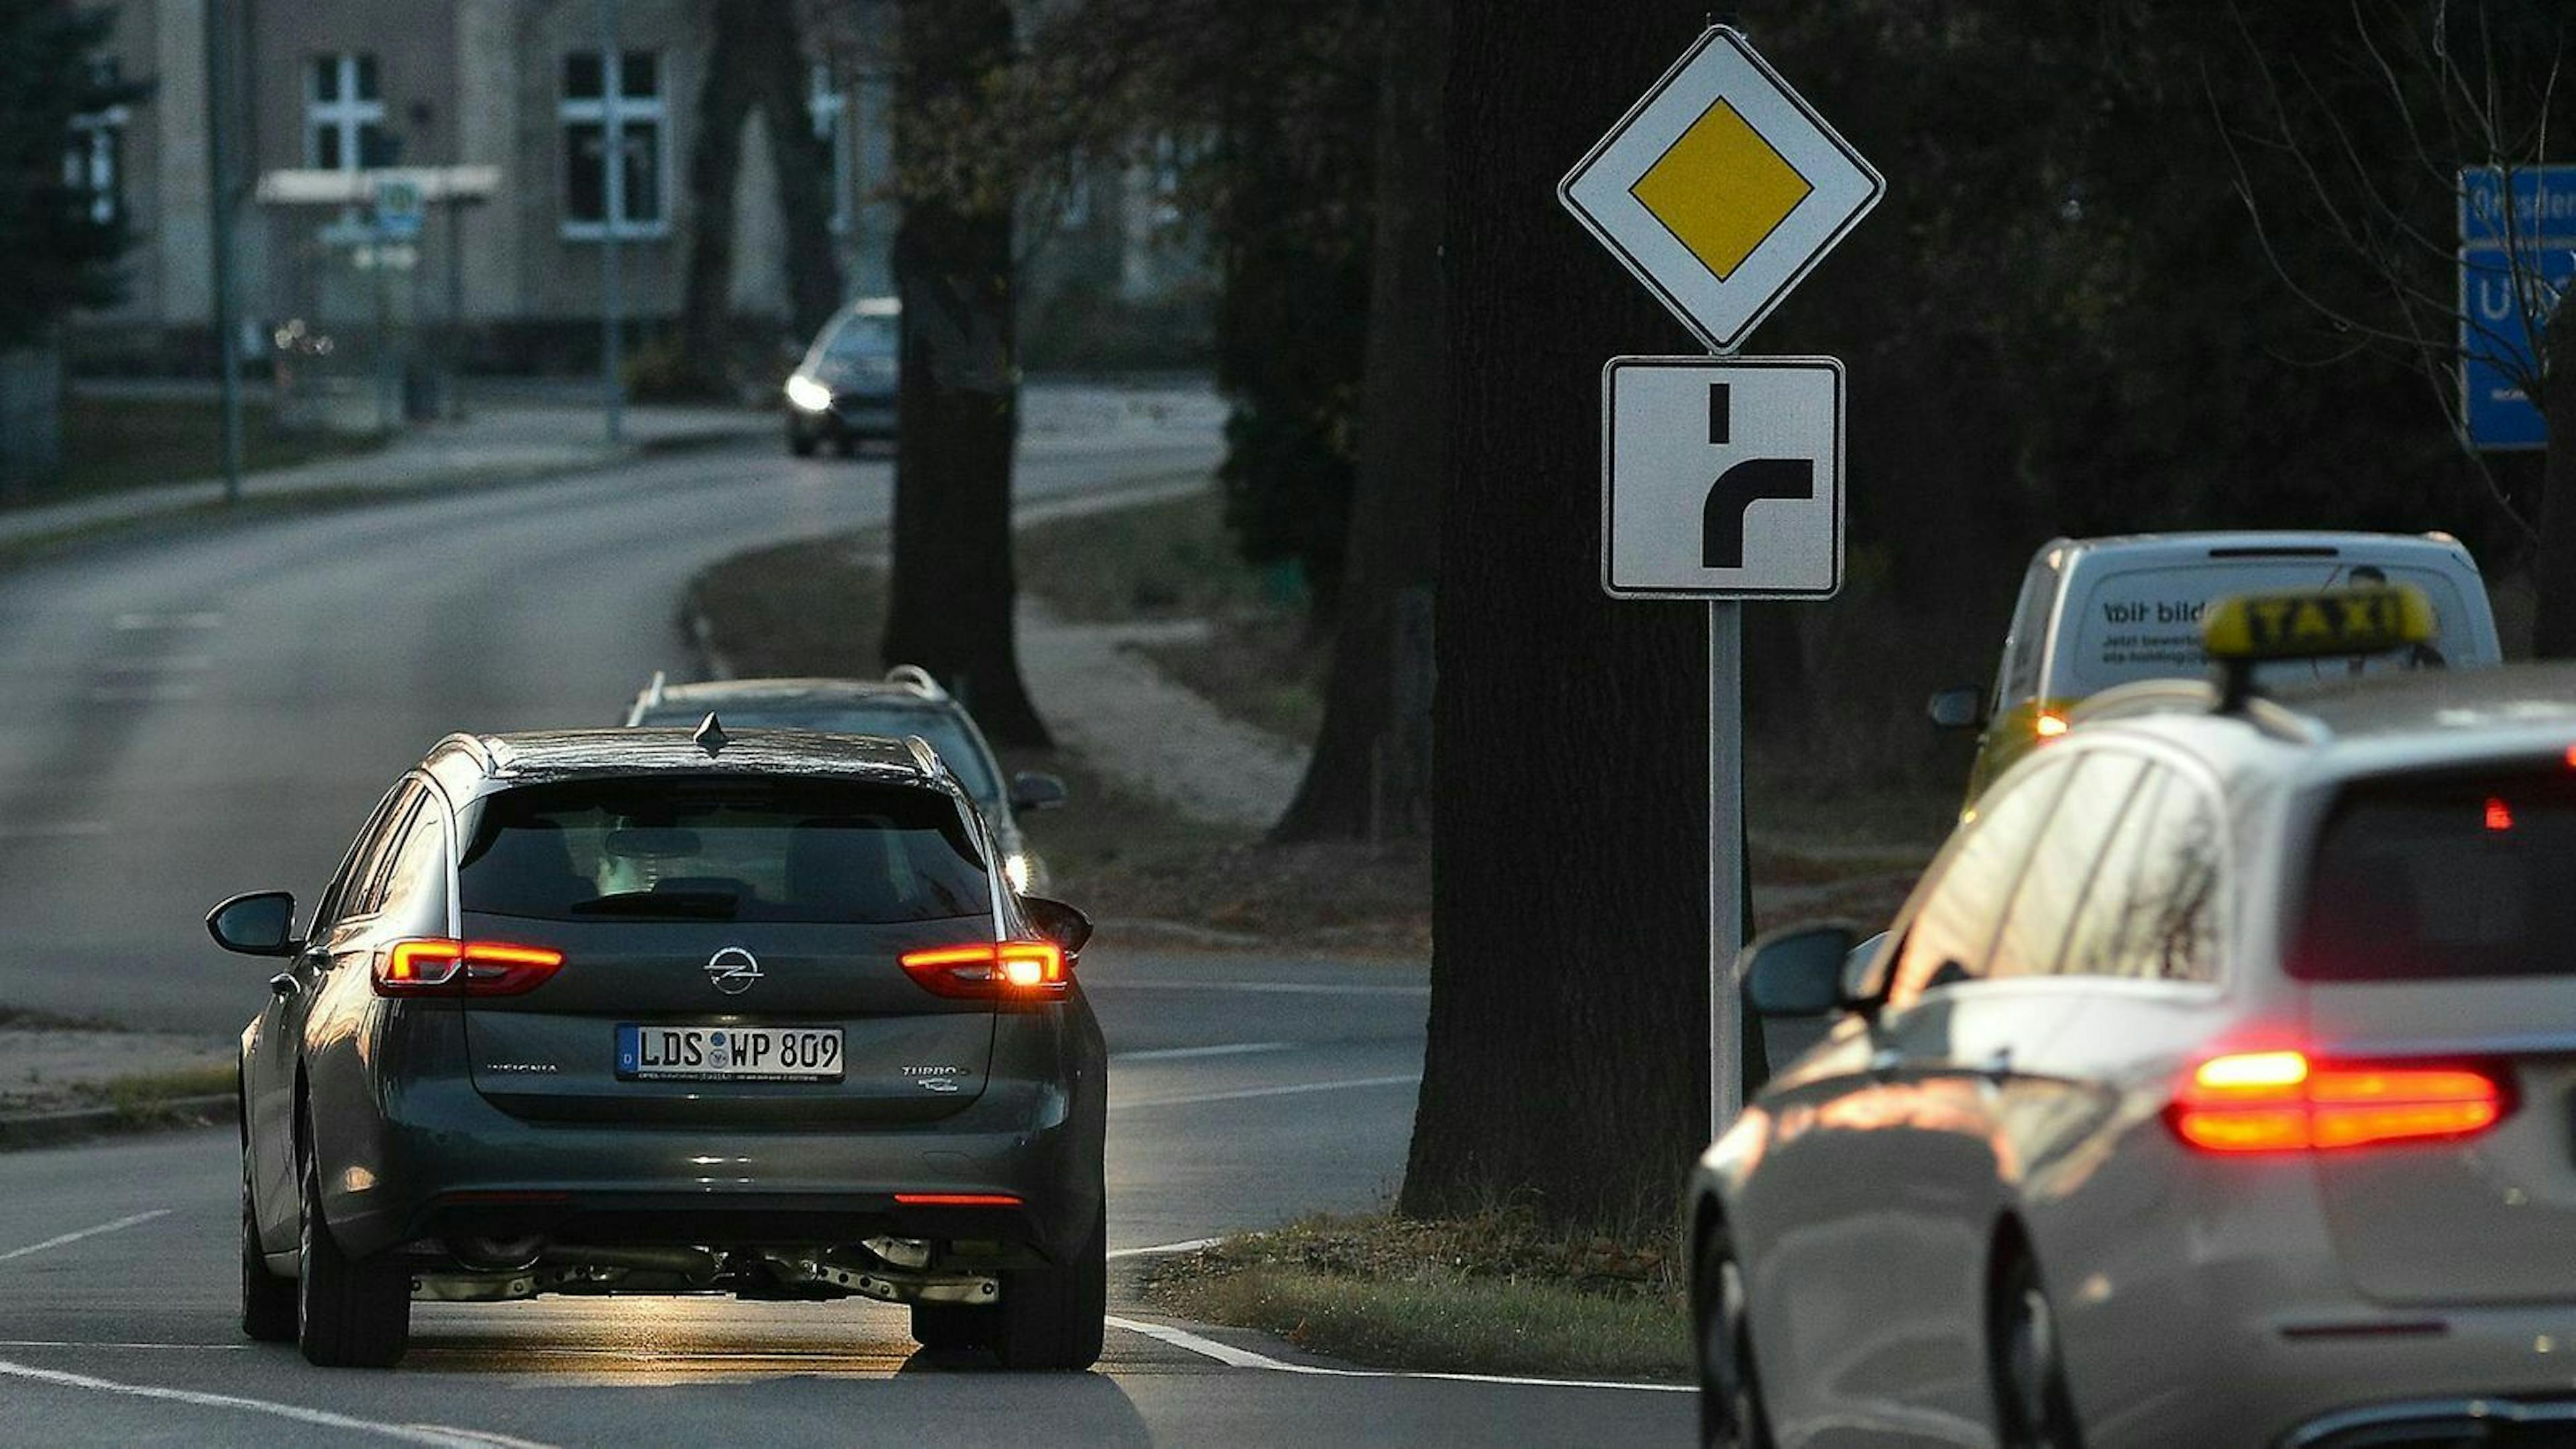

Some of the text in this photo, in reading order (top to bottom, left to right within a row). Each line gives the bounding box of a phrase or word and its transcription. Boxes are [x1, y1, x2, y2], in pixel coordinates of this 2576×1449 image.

[2157, 601, 2206, 623] bild
[2250, 596, 2399, 645] TAXI
[623, 1053, 631, 1064] D
[641, 1031, 839, 1068] LDS WP 809
